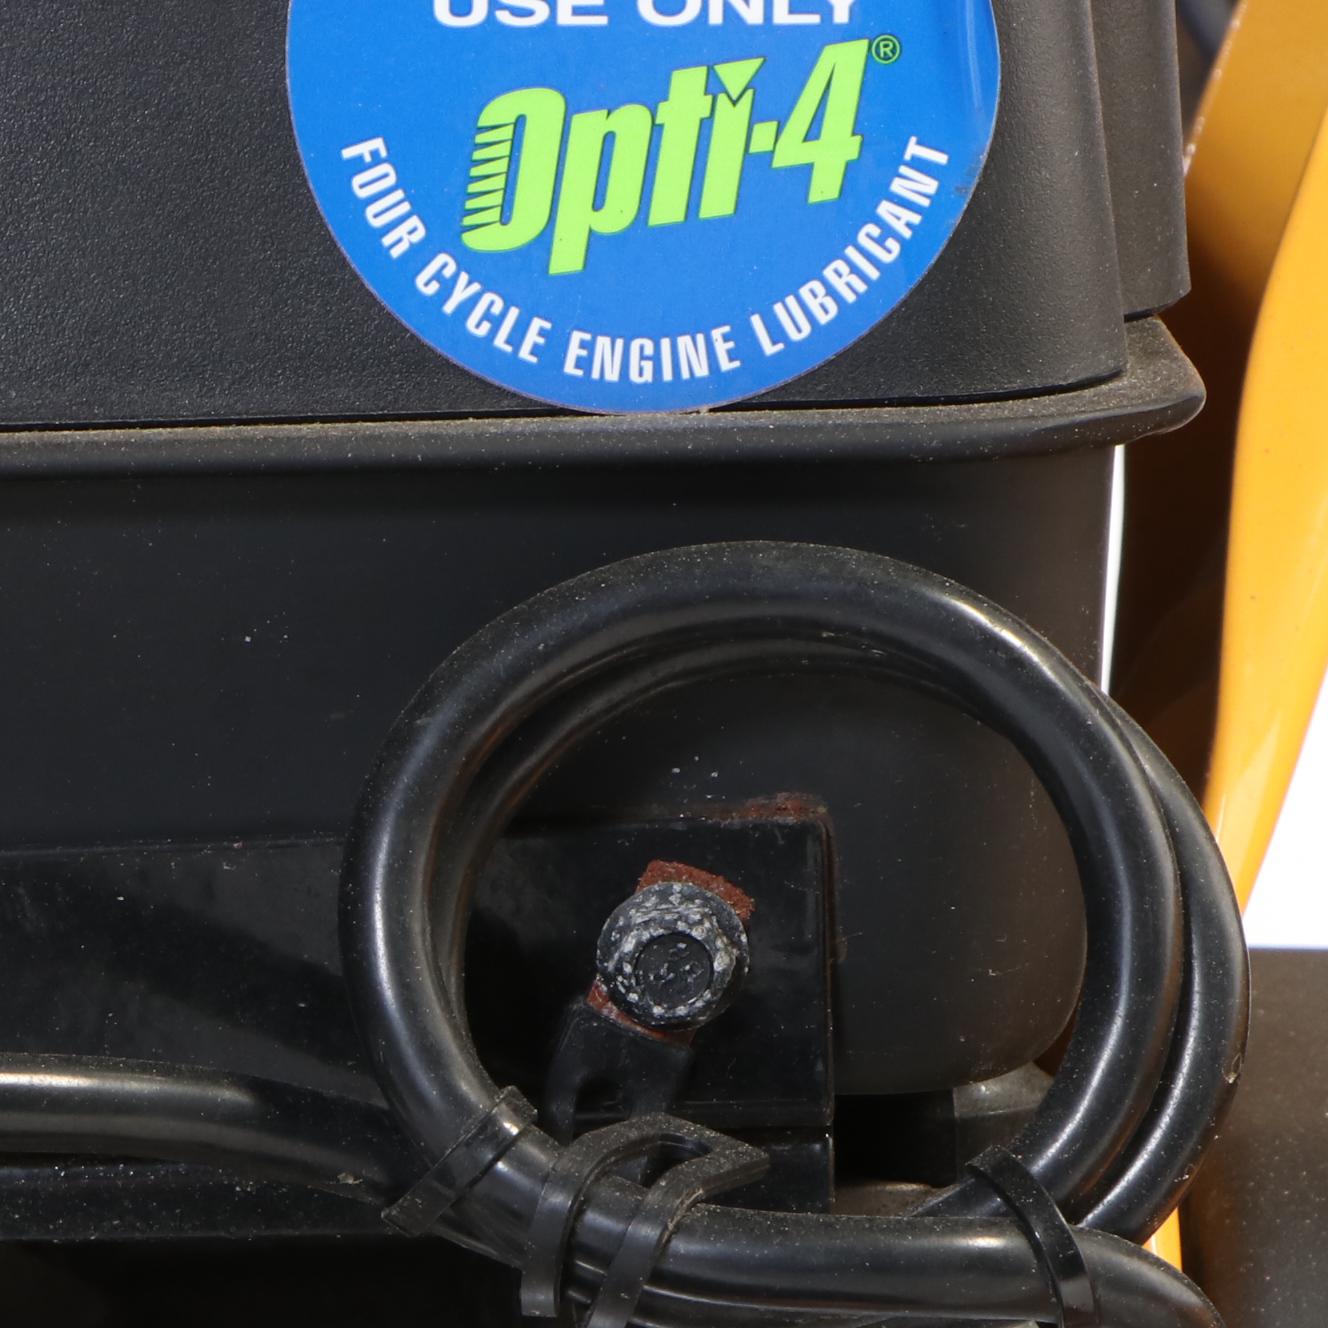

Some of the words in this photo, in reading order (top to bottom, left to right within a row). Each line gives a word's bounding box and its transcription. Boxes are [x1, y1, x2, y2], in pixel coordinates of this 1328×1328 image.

[433, 0, 608, 28] USE
[637, 0, 859, 27] ONLY
[341, 136, 426, 259] FOUR
[414, 252, 552, 364] CYCLE
[564, 325, 741, 383] ENGINE
[750, 136, 951, 356] LUBRICANT
